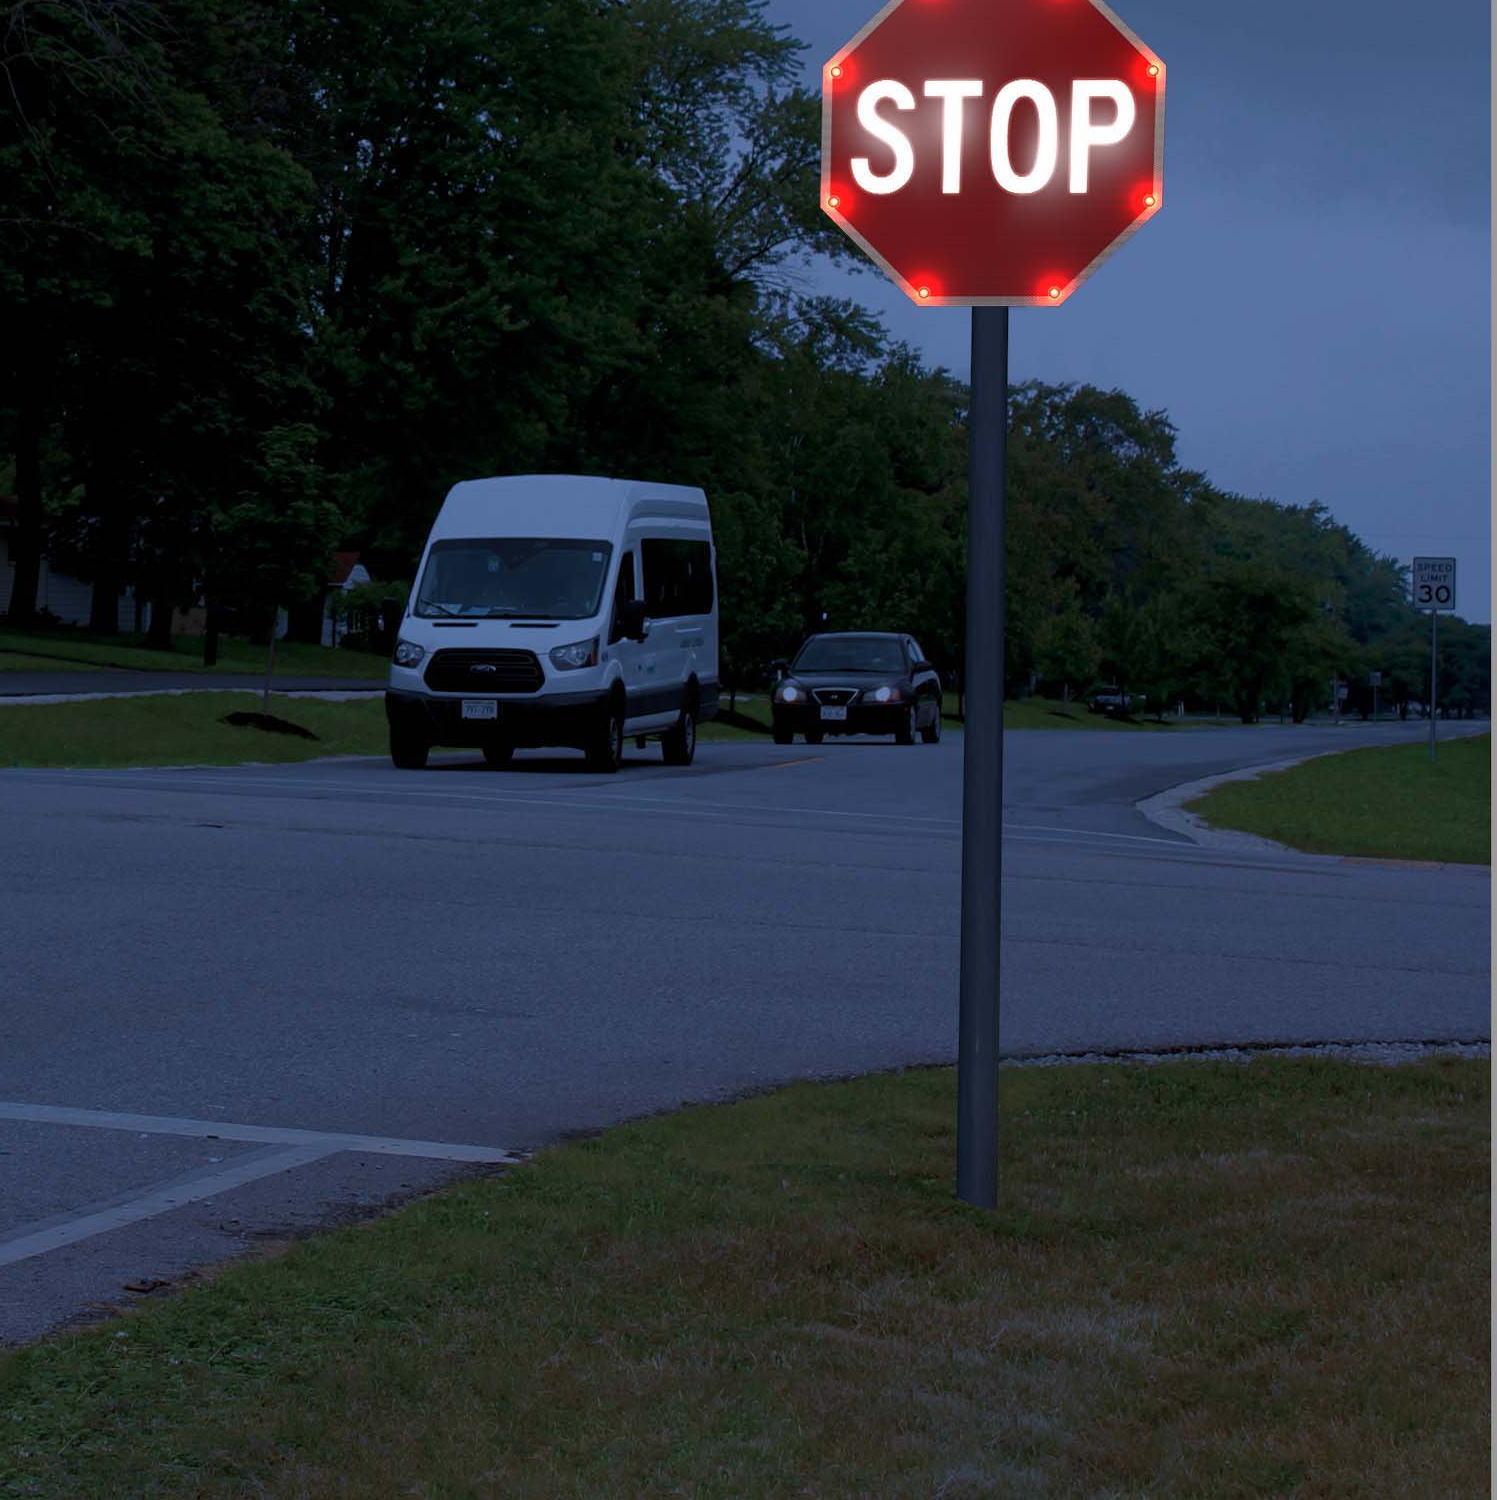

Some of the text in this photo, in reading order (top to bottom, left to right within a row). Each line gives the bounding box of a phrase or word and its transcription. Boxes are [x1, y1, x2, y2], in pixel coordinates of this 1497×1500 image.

[850, 78, 1136, 195] STOP
[1416, 563, 1453, 573] SPEED
[1420, 574, 1448, 582] LIMIT
[1418, 585, 1450, 604] 30
